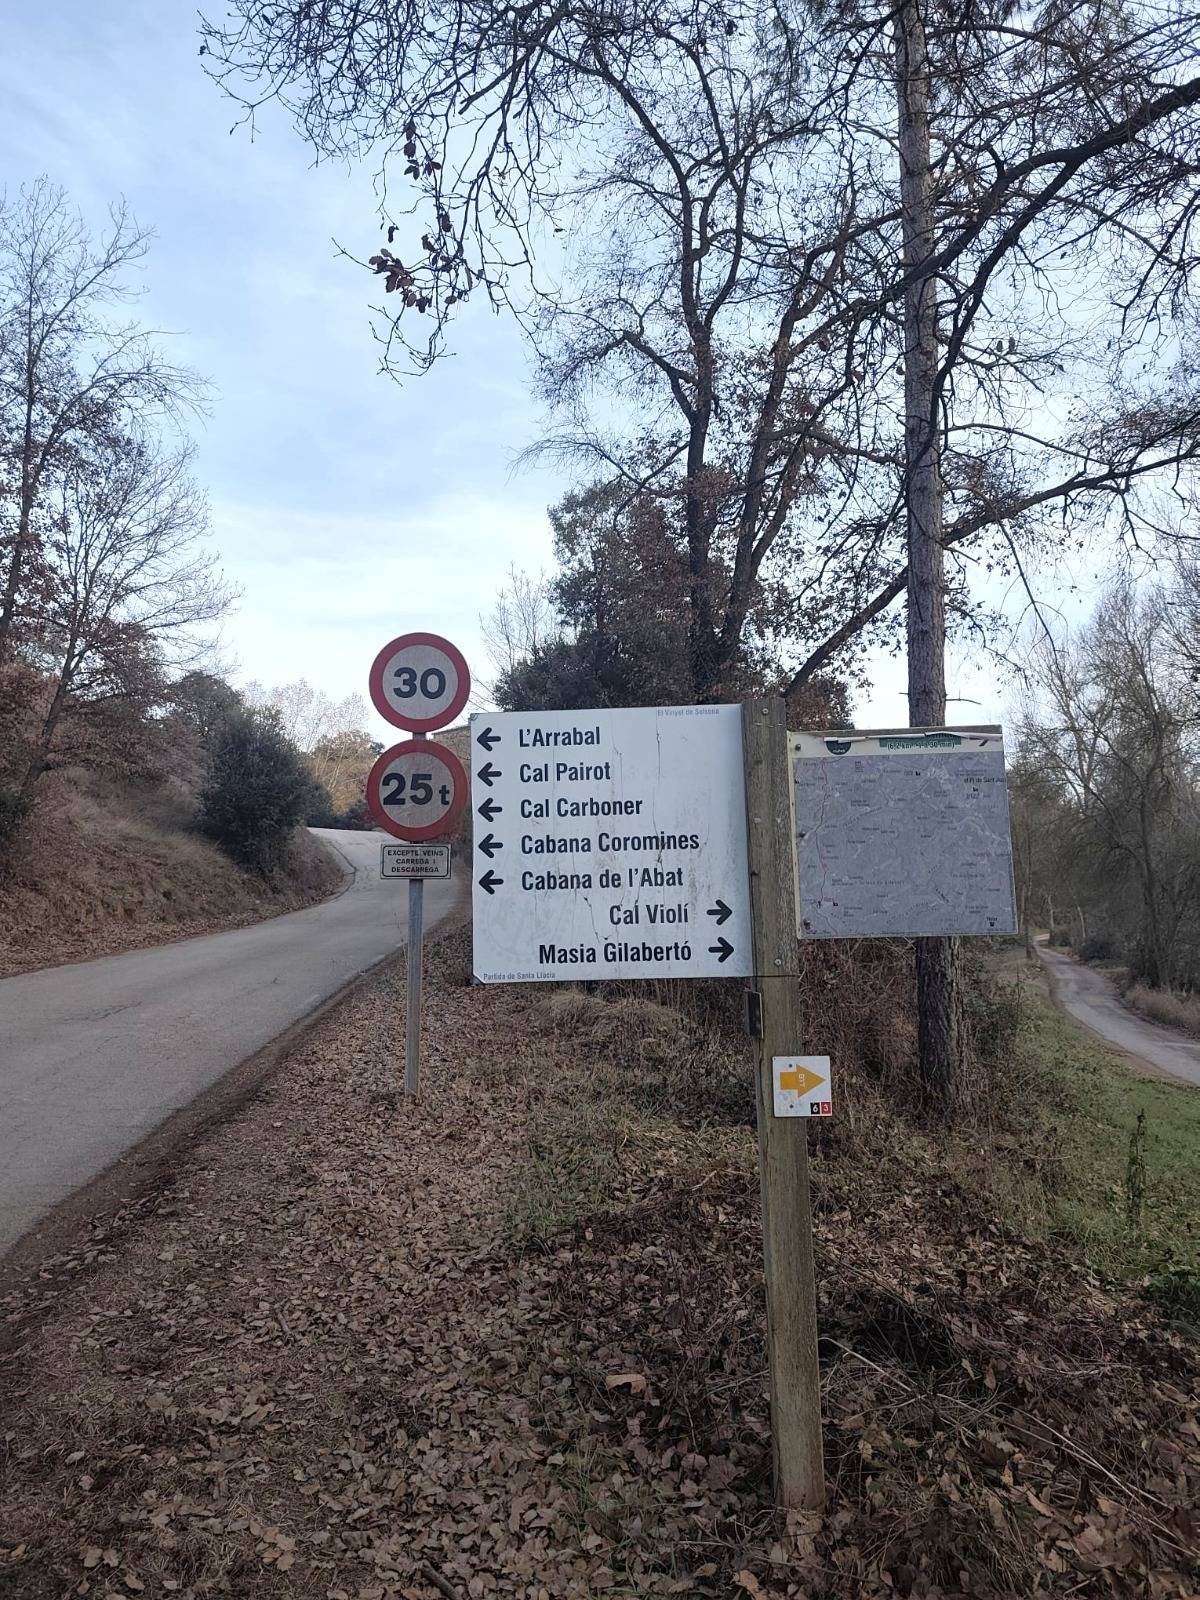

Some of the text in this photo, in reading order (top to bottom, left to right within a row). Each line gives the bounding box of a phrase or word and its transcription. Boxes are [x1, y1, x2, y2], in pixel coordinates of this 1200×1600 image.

[393, 667, 446, 699] 30
[519, 761, 611, 783] Cal Pairot
[520, 797, 643, 818] Cal Carboner
[521, 831, 700, 854] Cabana Coromines
[521, 870, 593, 891] Cabana
[599, 868, 622, 889] de
[609, 902, 689, 925] Cal Violí
[538, 940, 692, 964] Masia Gilabertó
[507, 972, 515, 980] de
[812, 1103, 829, 1113] 6 3
